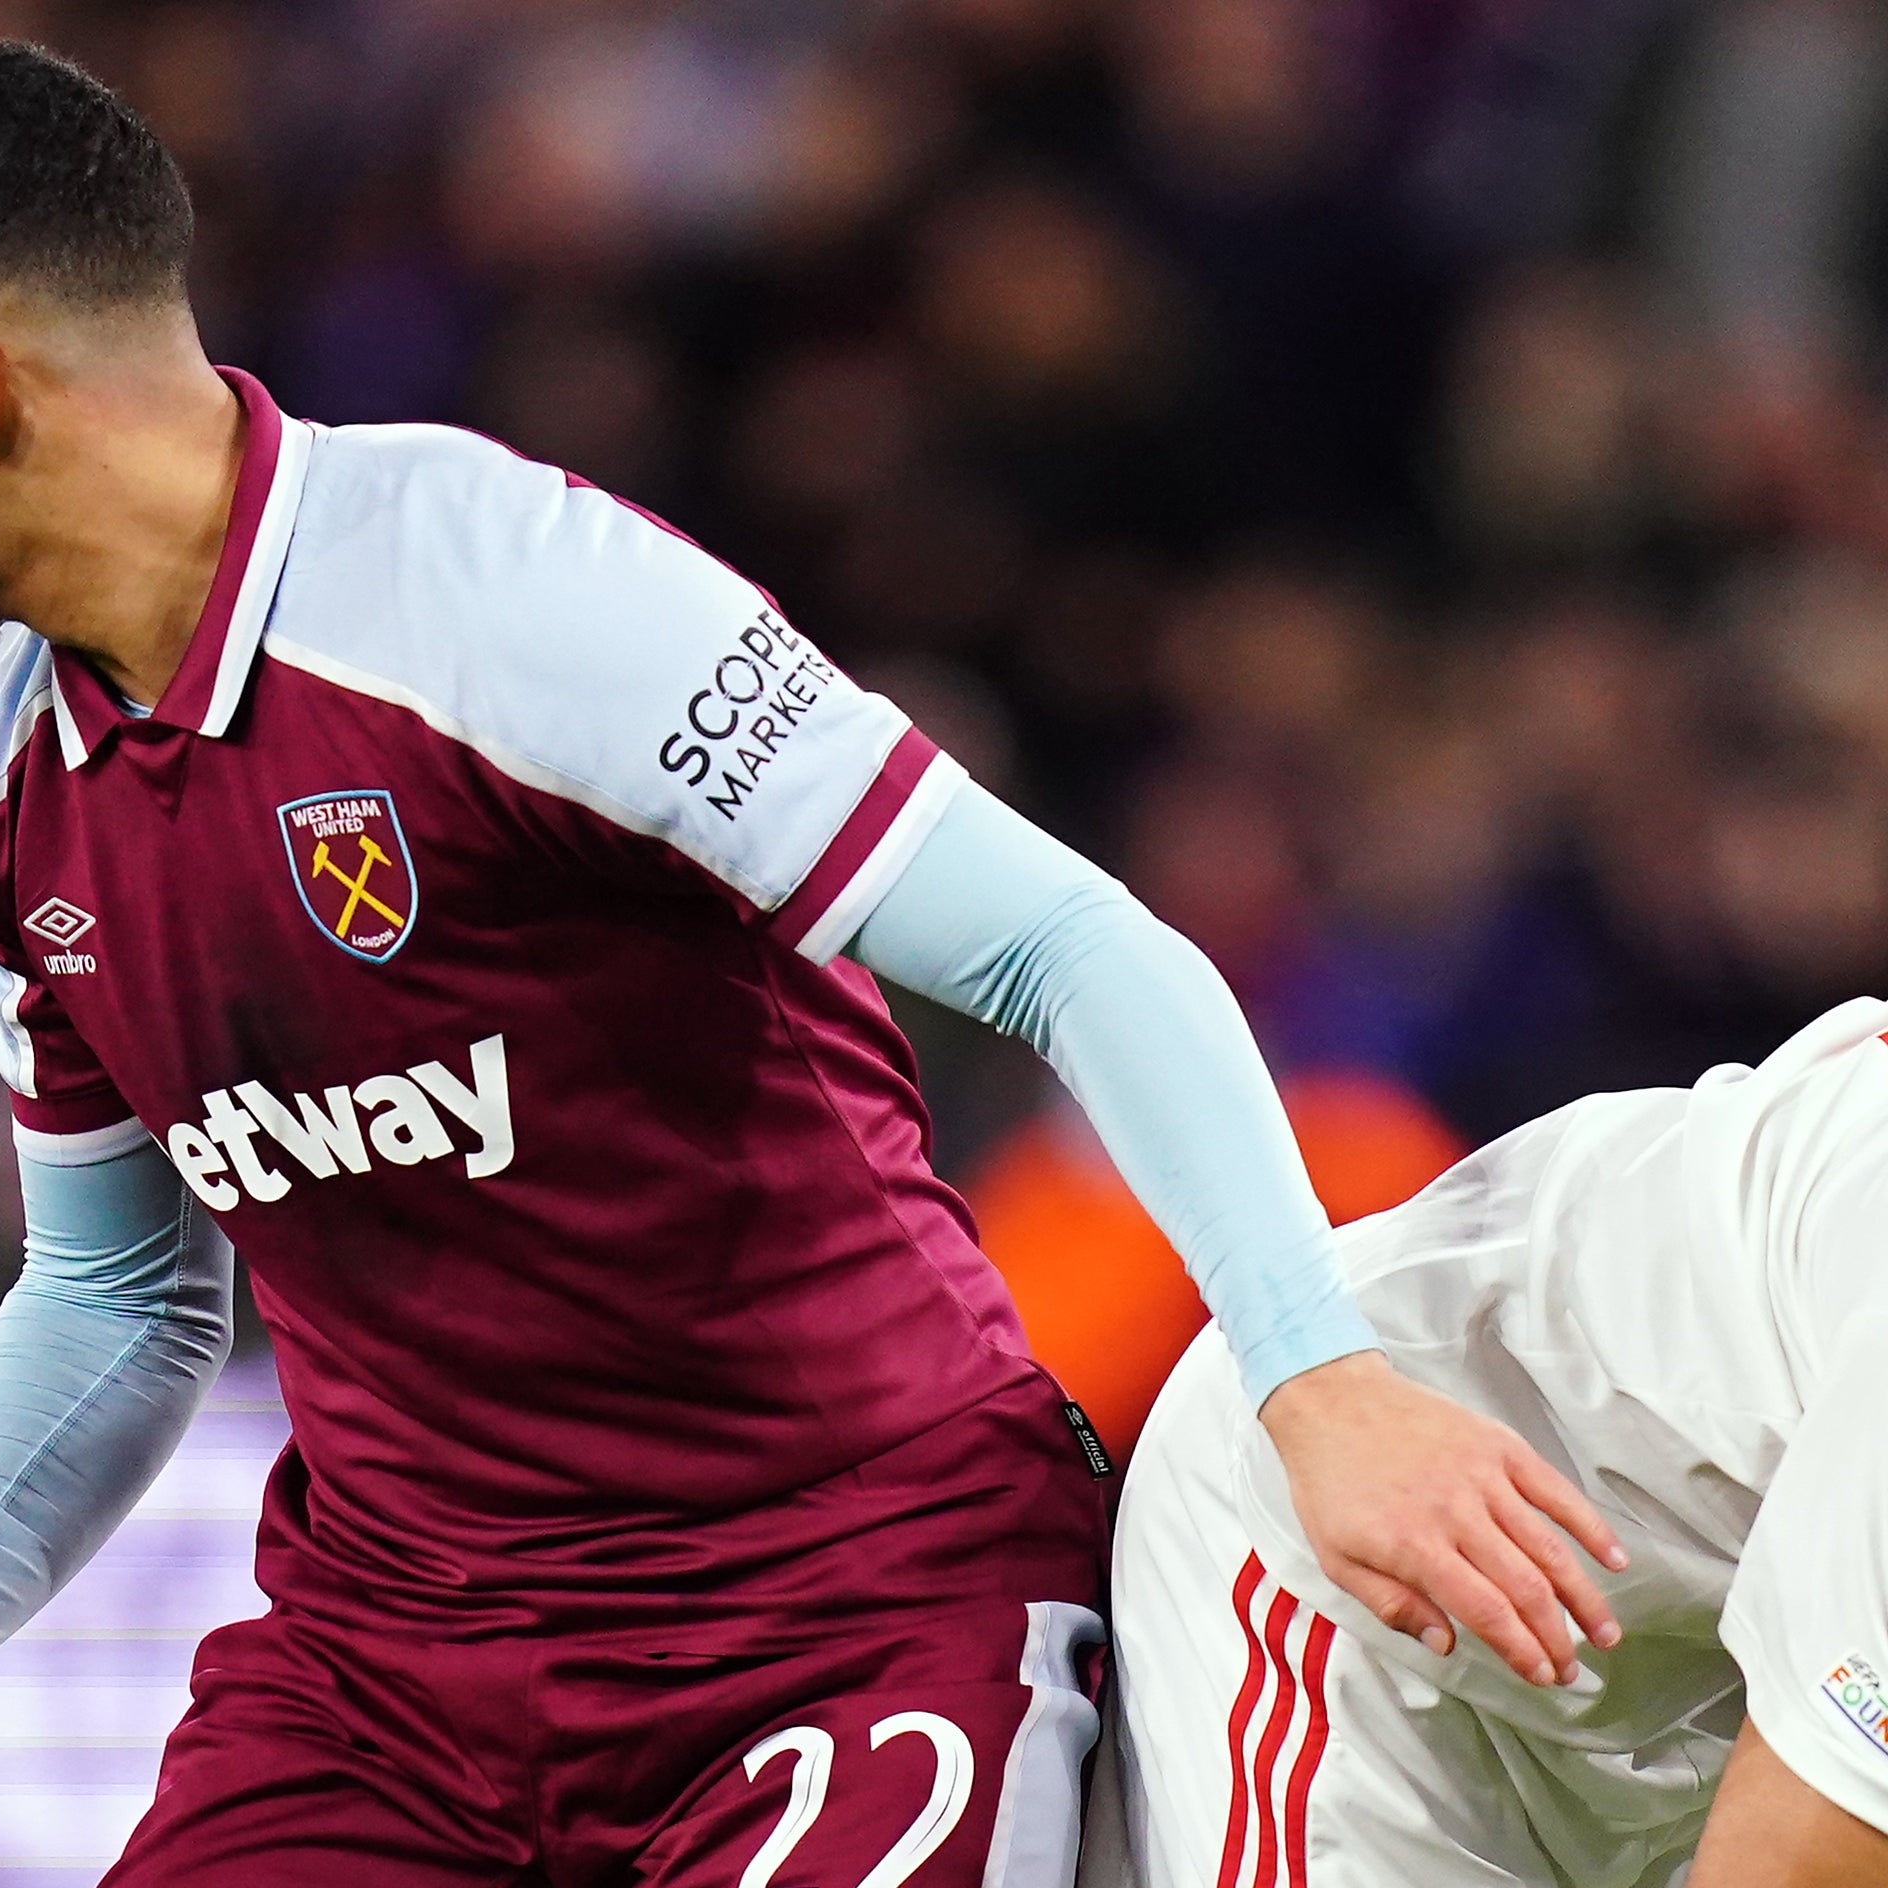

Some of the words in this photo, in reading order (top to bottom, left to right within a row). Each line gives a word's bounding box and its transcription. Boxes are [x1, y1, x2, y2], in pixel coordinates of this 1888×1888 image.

[659, 610, 800, 787] SCOPE
[706, 653, 836, 821] MARKETS
[291, 802, 334, 828] WEST
[336, 799, 382, 820] HAM
[313, 817, 365, 839] UNITED
[352, 928, 396, 948] LONDON
[43, 949, 96, 975] umbro
[167, 1033, 515, 1212] etway
